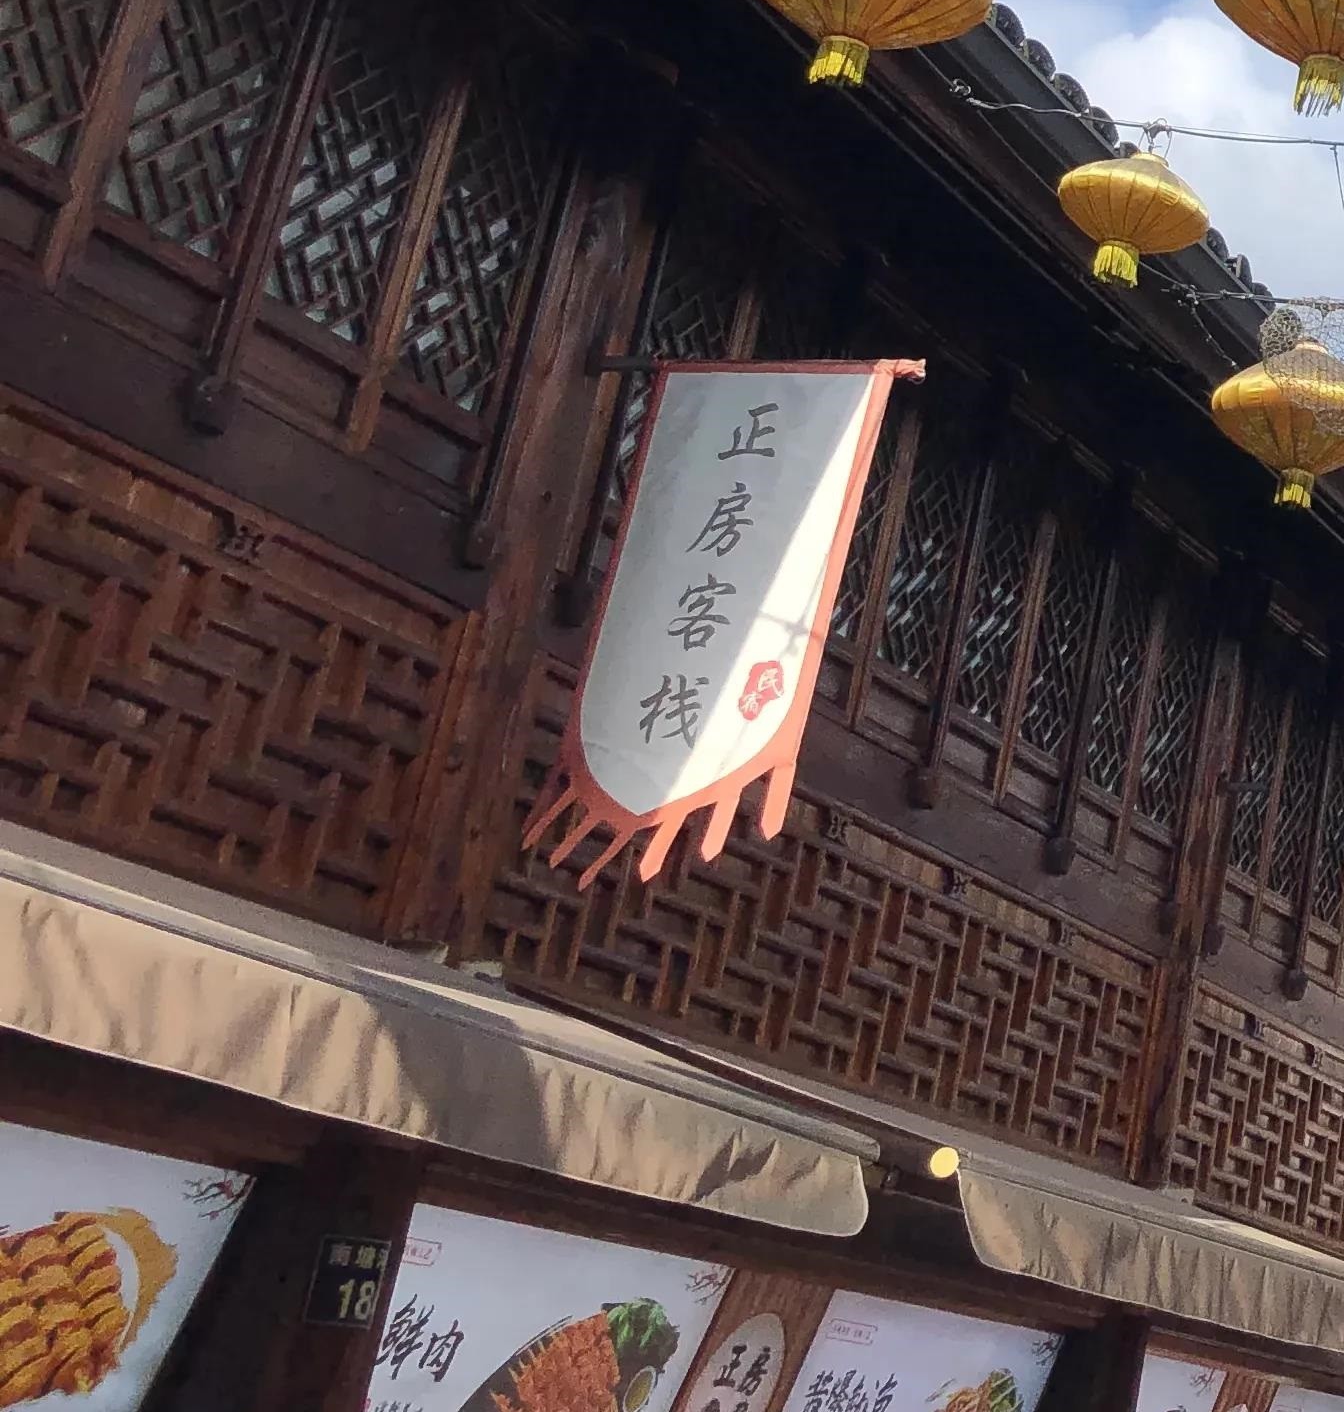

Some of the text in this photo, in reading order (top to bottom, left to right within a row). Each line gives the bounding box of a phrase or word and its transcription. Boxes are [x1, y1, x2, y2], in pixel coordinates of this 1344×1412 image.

[639, 403, 779, 748] 正房客栈
[338, 1278, 376, 1321] 18
[713, 1344, 772, 1397] 正房
